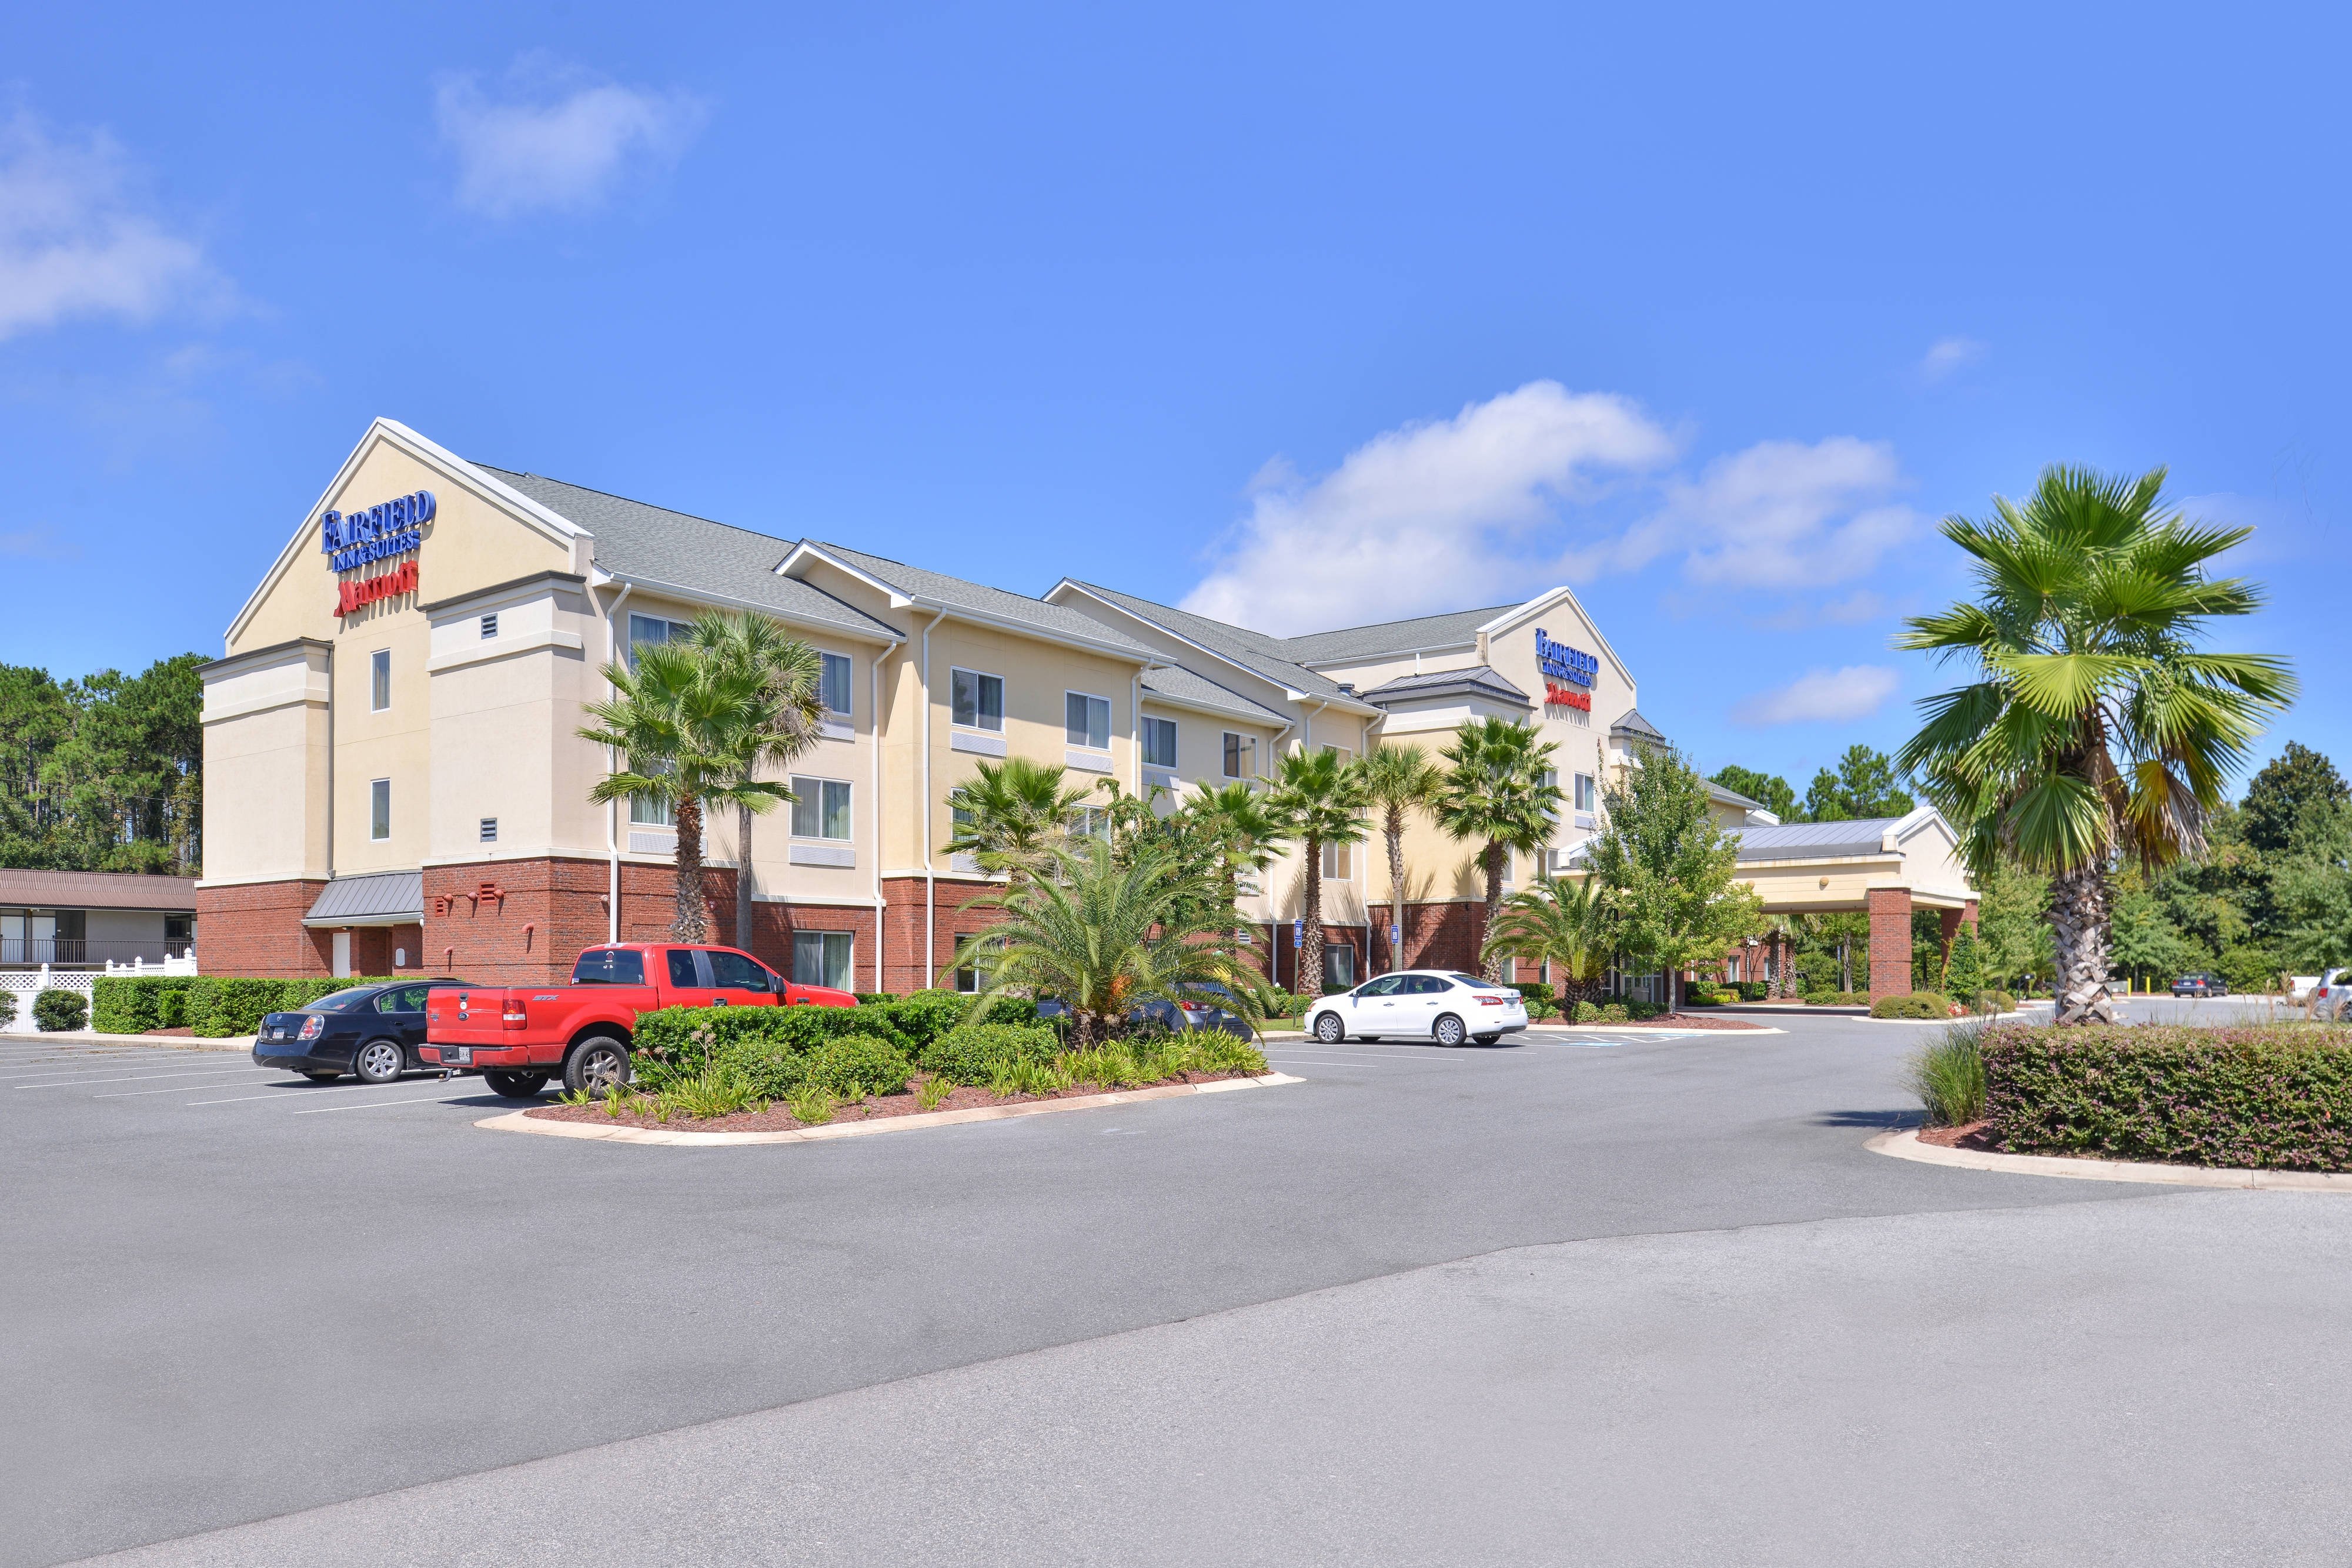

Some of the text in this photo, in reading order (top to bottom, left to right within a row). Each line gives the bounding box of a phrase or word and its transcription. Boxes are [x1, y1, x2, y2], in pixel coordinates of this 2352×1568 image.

[320, 490, 436, 554] FAIRFIELD
[332, 549, 357, 573] INN
[368, 531, 420, 559] SUITES
[333, 560, 418, 617] Marriott
[1535, 628, 1599, 674] FAIRFIELD
[1543, 662, 1561, 677] INN
[1569, 669, 1592, 687] SUITES
